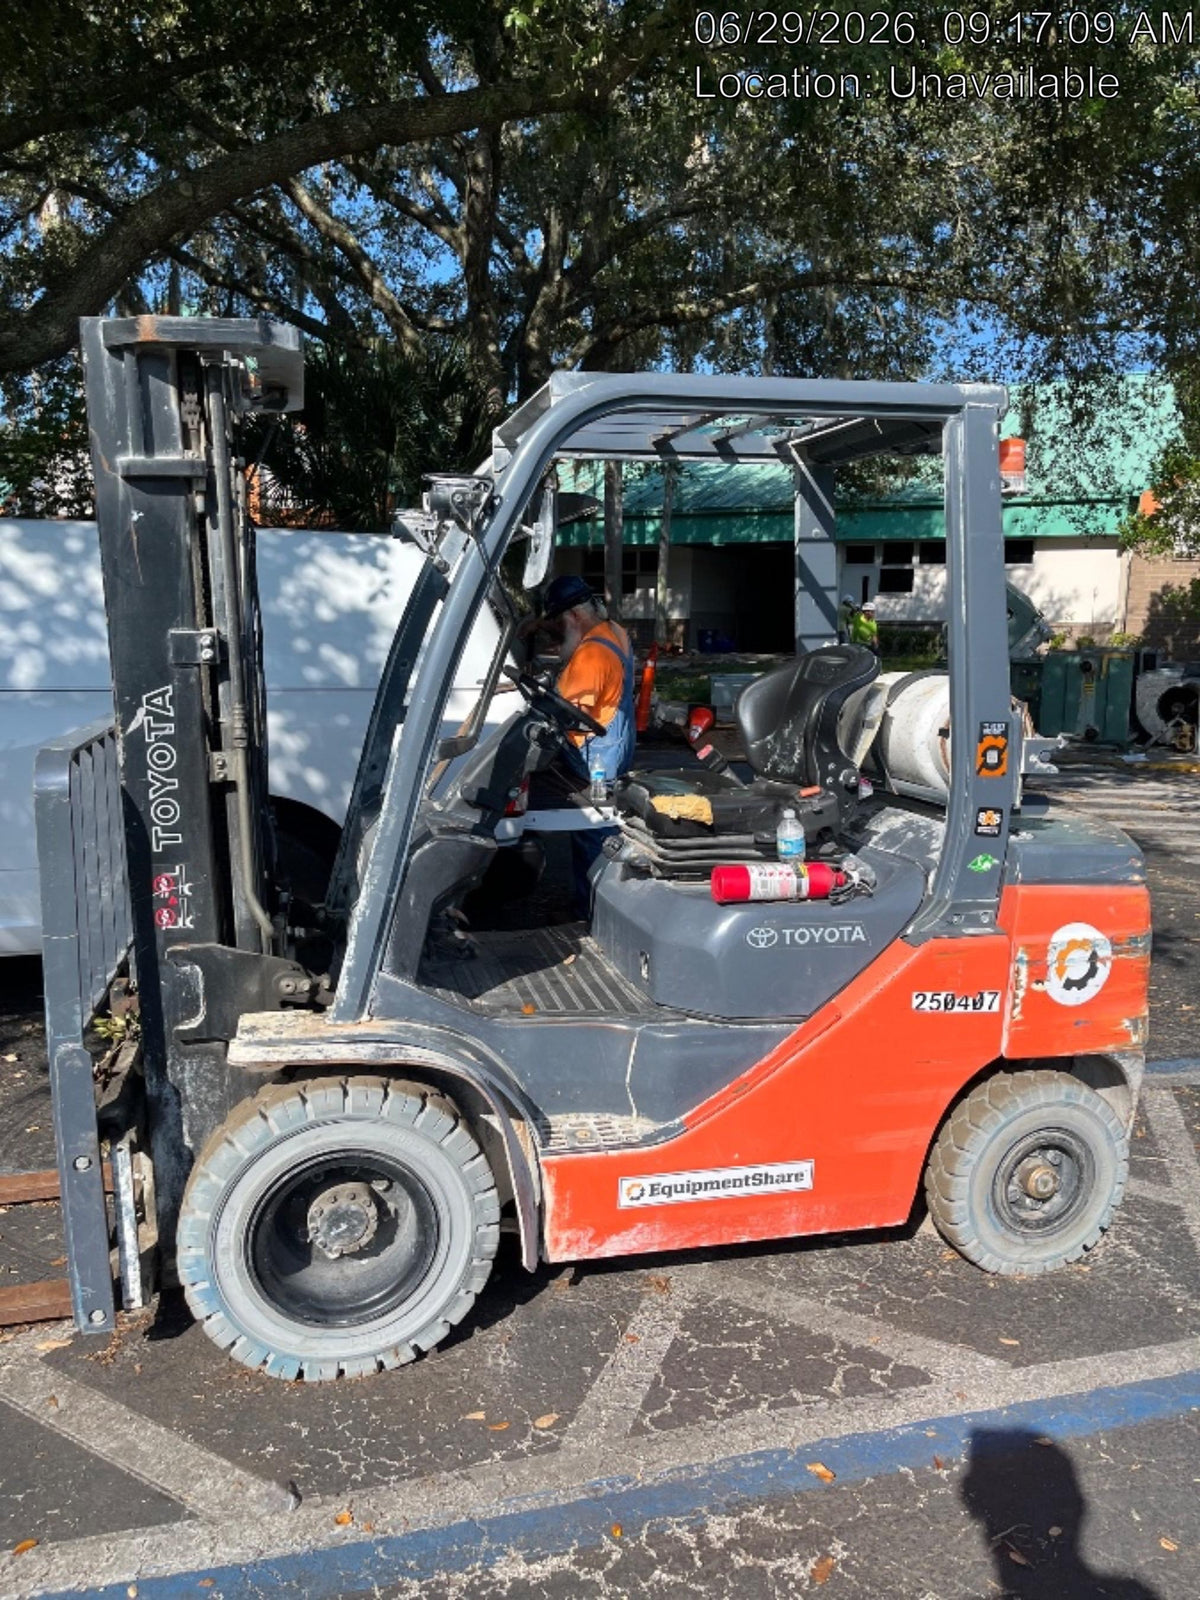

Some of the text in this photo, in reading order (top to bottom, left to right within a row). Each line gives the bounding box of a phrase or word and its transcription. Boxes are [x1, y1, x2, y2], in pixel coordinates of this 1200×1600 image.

[142, 685, 183, 852] TOYOTA
[782, 926, 867, 945] TOYOTA
[648, 1171, 804, 1198] EquipmentShare
